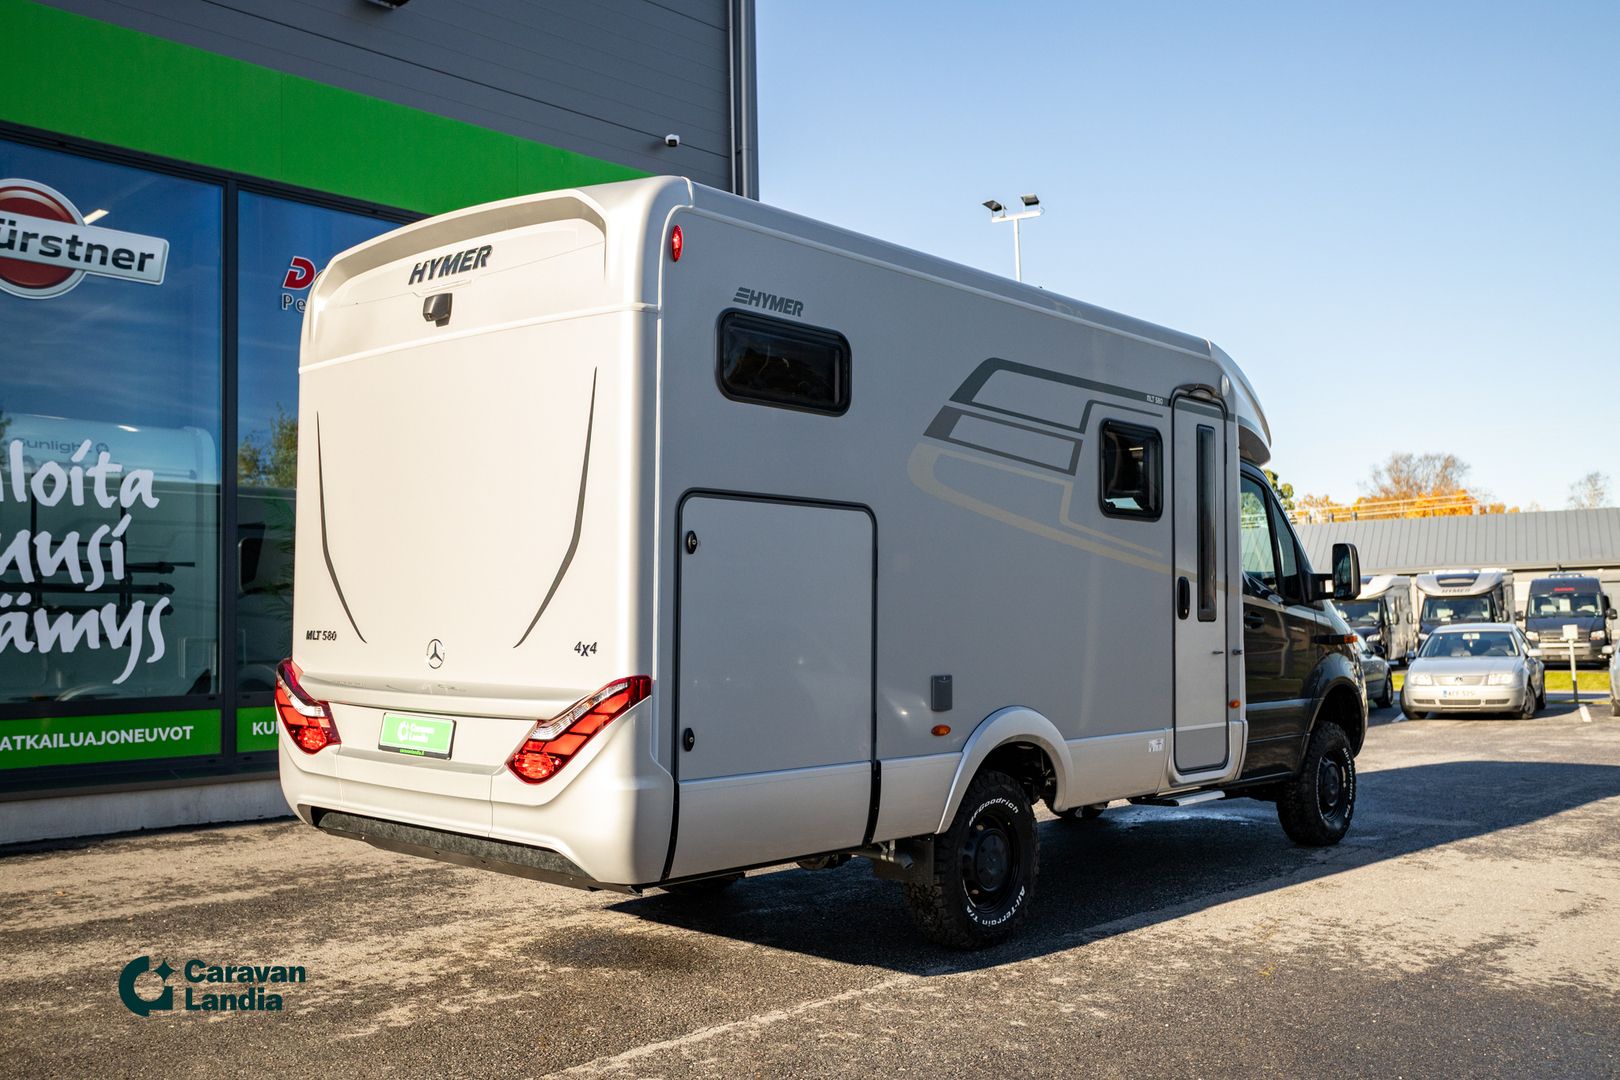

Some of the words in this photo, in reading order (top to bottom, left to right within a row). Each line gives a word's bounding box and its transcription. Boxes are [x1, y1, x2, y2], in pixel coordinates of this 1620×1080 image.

[283, 256, 323, 290] D
[408, 245, 493, 285] HYMER
[747, 290, 804, 317] HYMER
[305, 630, 322, 641] MLT
[321, 630, 337, 641] 580
[573, 641, 598, 657] 4x4
[0, 725, 194, 751] ATKAILUAJONEUVOT
[252, 721, 279, 735] KU
